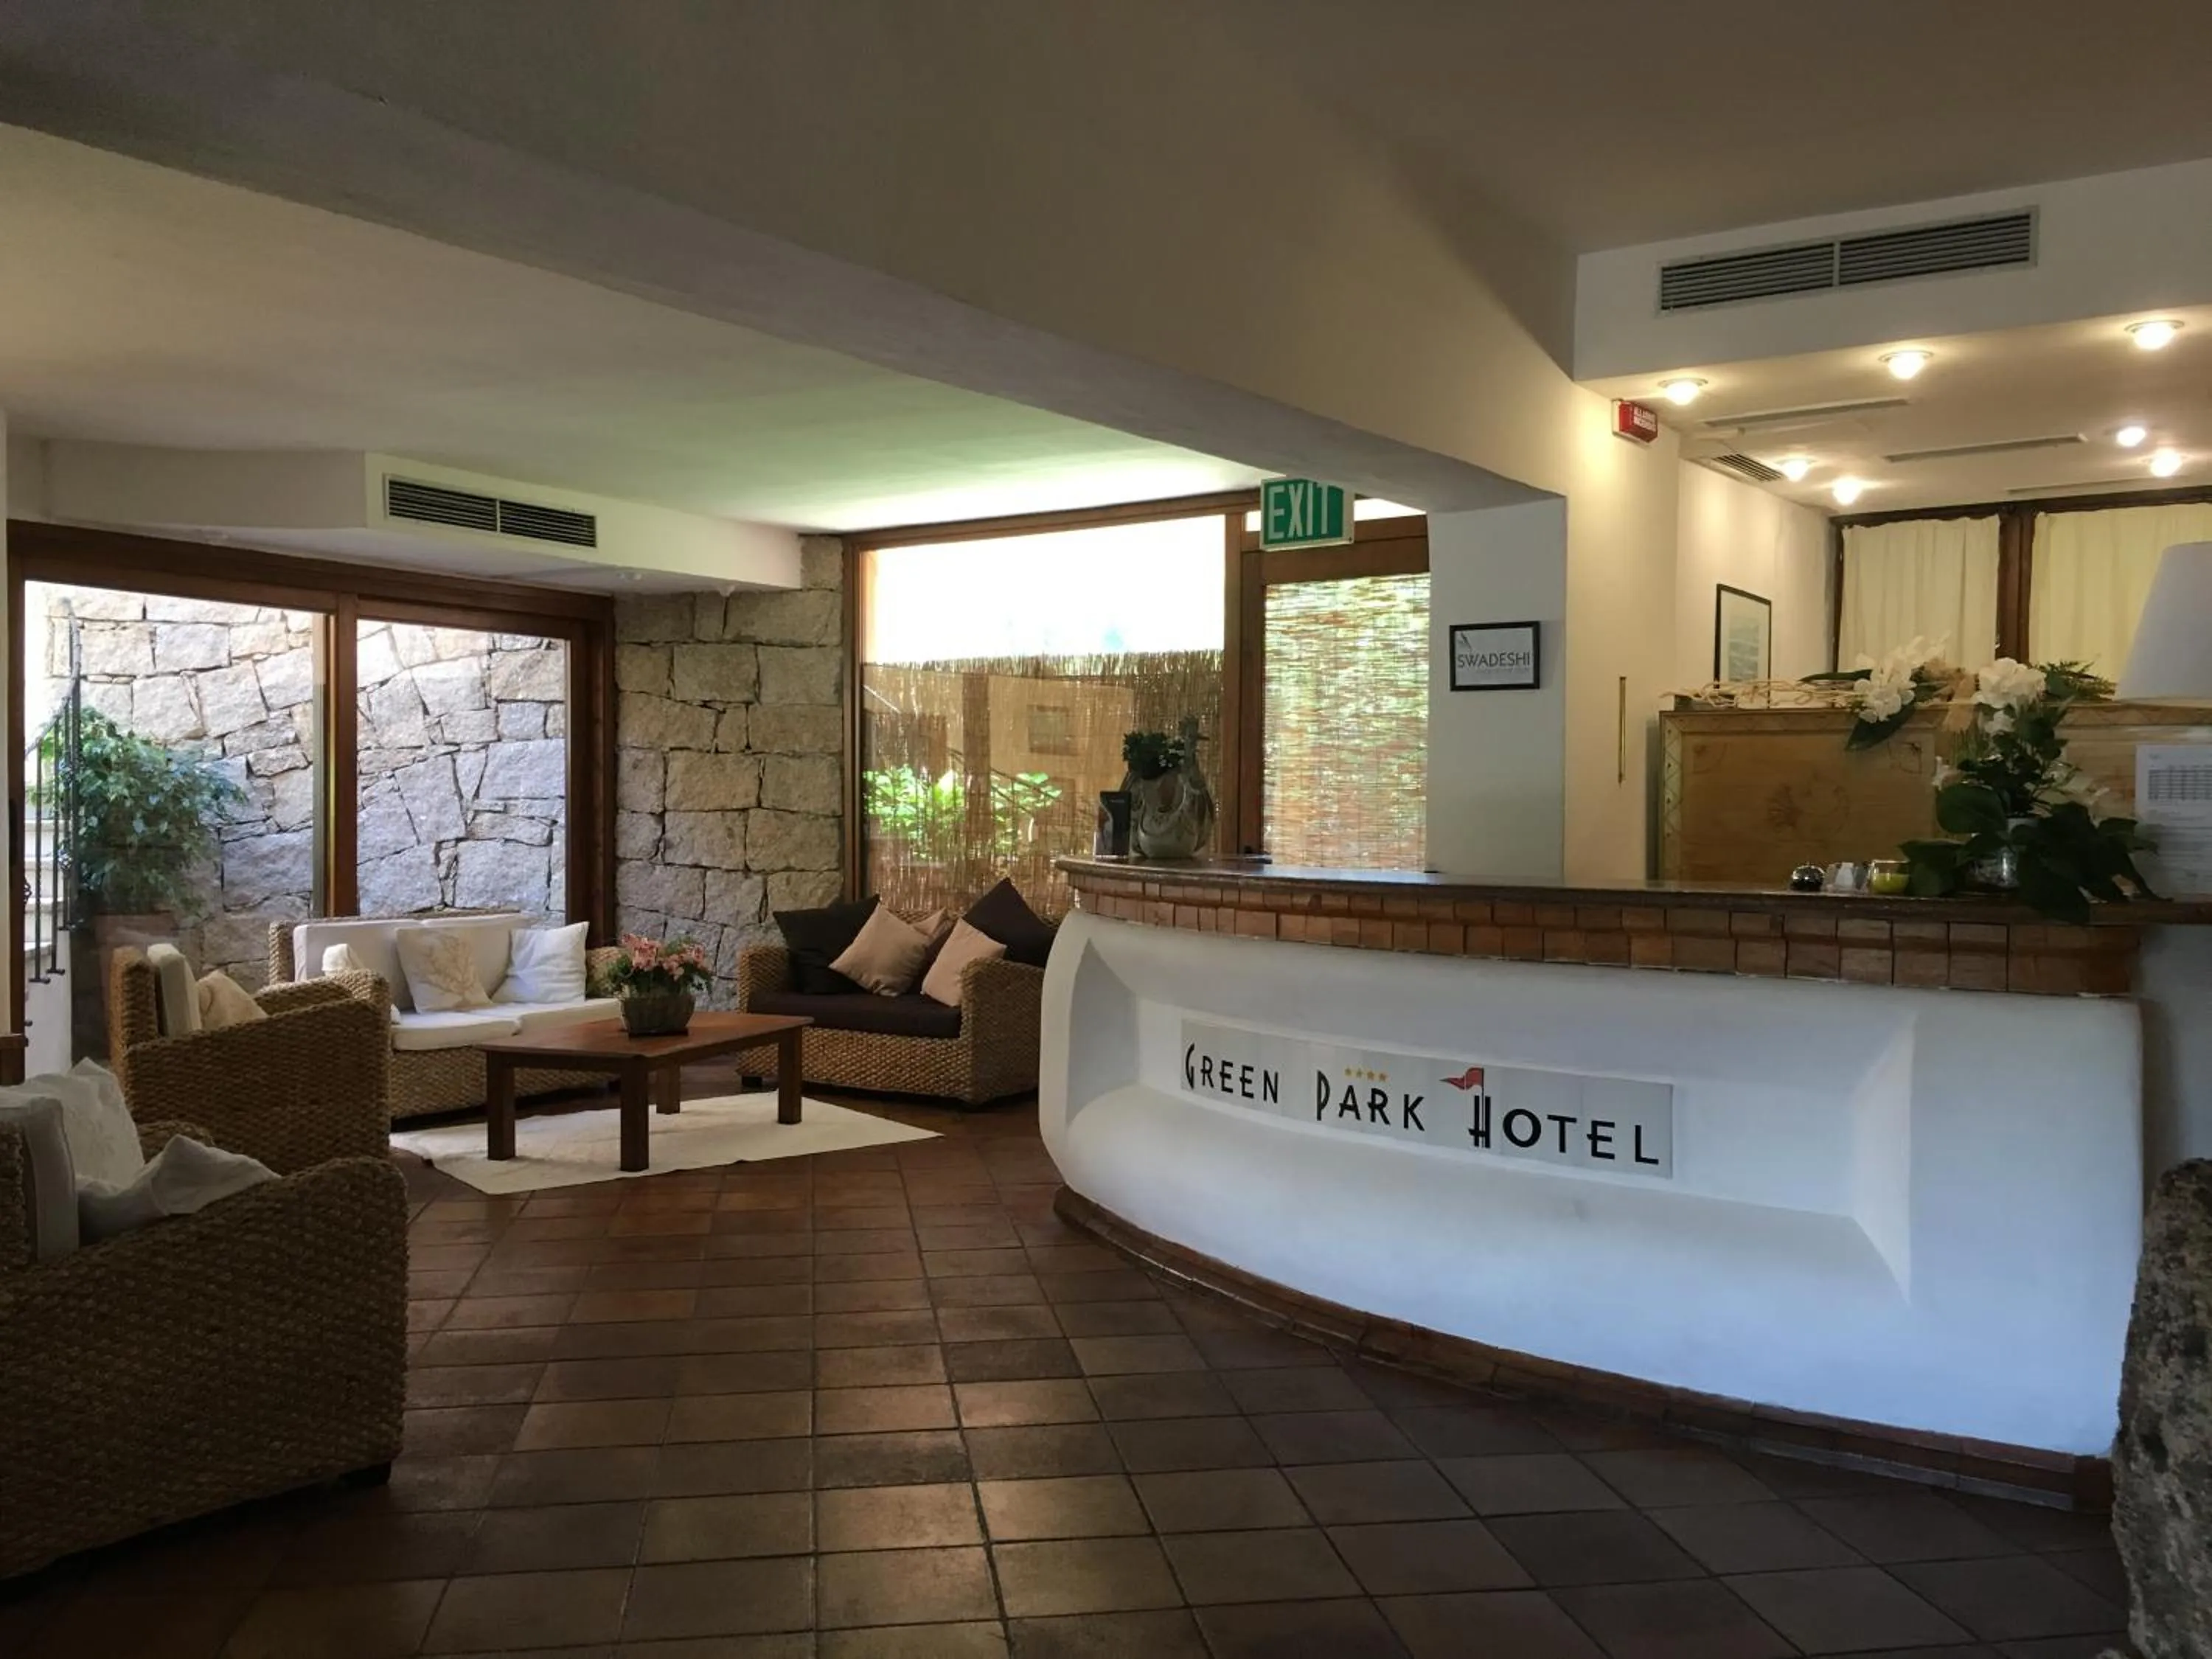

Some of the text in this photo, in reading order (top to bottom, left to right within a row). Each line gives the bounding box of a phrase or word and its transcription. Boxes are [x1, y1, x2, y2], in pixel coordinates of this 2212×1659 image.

[1267, 483, 1328, 540] EXIT
[1457, 652, 1531, 668] SWADESHI
[1185, 1043, 1660, 1165] GREEN PARK HOTEL
